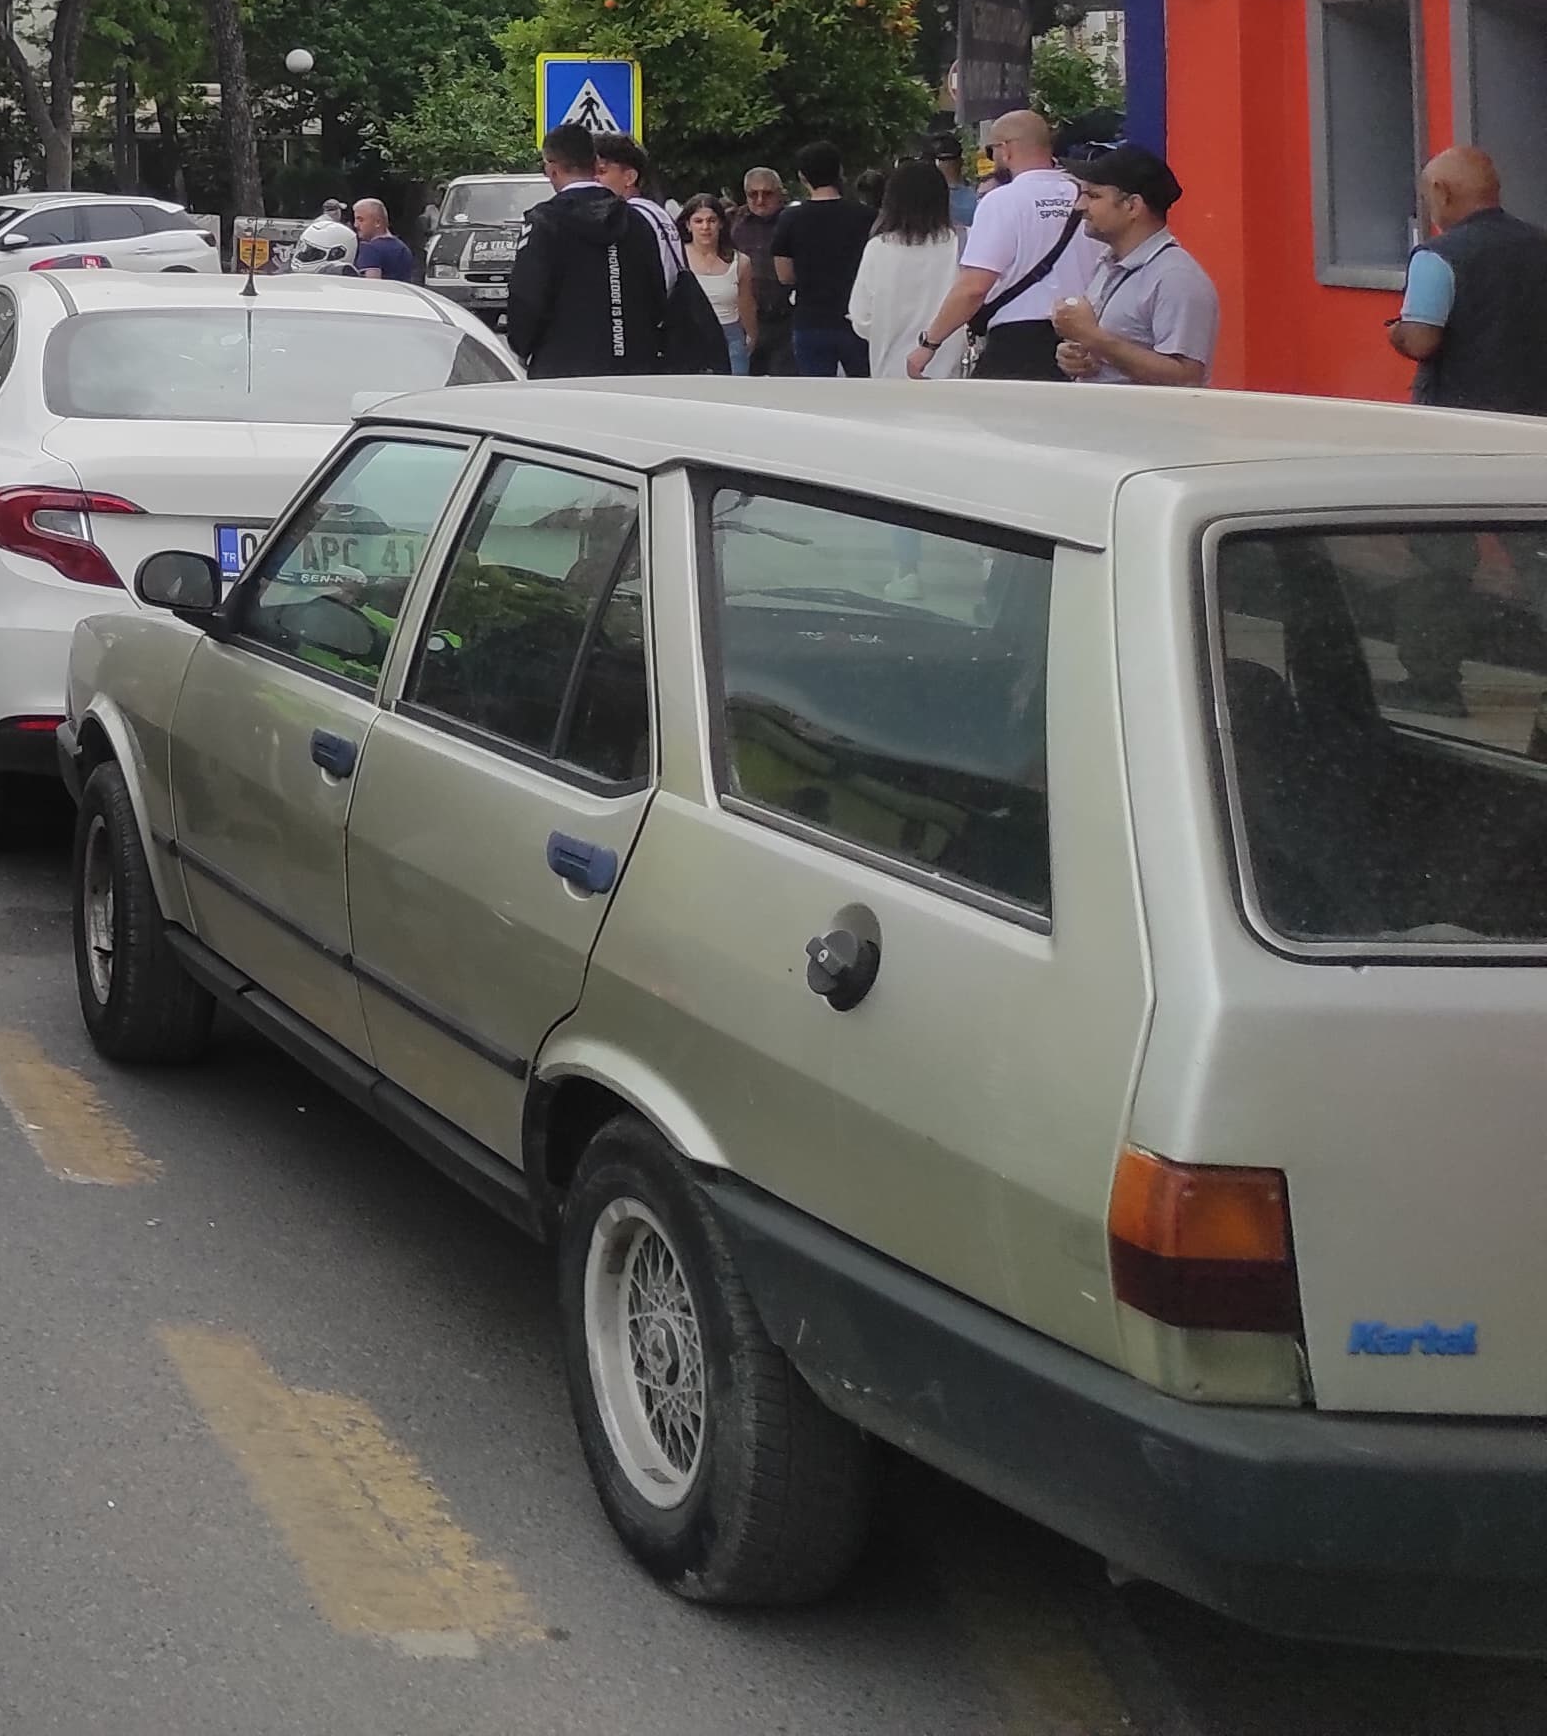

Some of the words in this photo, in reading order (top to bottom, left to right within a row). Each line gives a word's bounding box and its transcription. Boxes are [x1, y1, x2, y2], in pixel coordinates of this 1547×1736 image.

[613, 319, 624, 356] POWER
[303, 536, 360, 572] APC
[1348, 1320, 1477, 1356] Kartal
